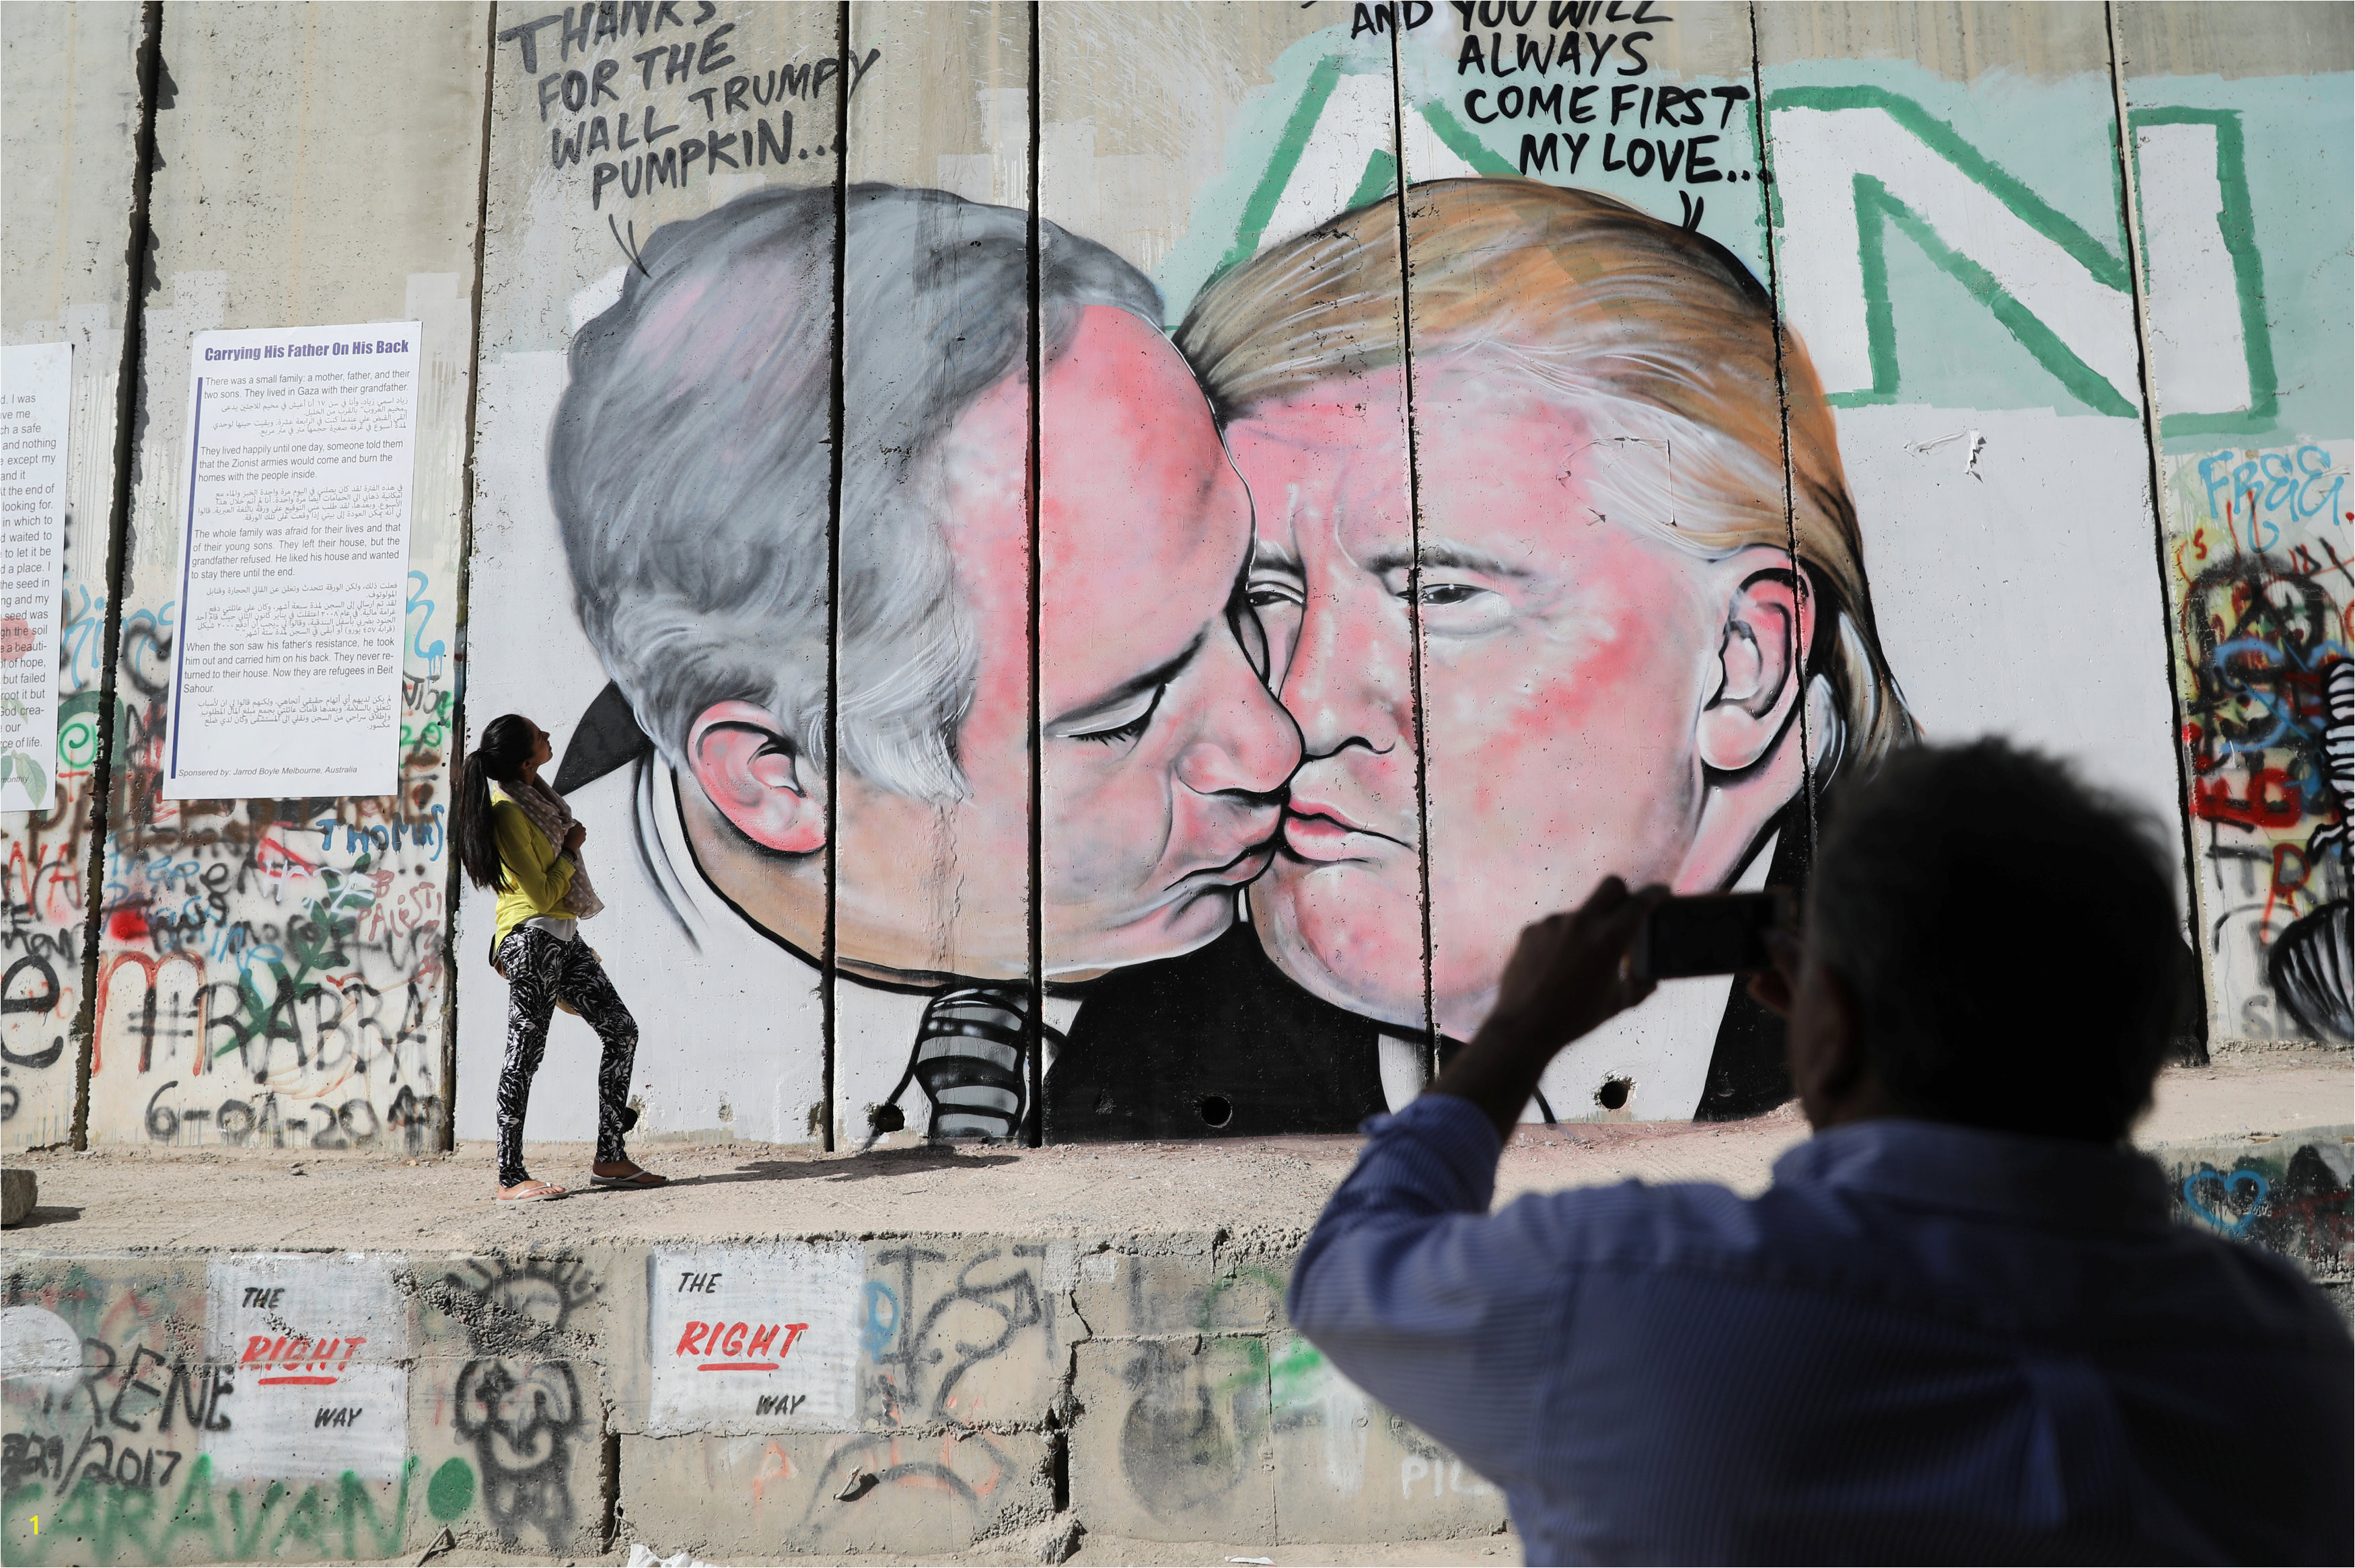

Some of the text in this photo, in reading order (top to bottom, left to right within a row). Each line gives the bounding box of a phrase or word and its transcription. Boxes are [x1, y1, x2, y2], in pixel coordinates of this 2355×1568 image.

[1350, 0, 1674, 39] AND YOU WILL
[1457, 31, 1654, 78] ALWAYS
[538, 23, 735, 122] FOR THE
[552, 48, 880, 170] WALL TRUMPY
[1463, 84, 1751, 129] COME FIRST
[592, 110, 838, 211] PUMPKIN...
[1519, 133, 1775, 185] MY LOVE...
[205, 339, 409, 361] Carrying His Father On His Back
[205, 377, 229, 385] There
[256, 375, 277, 384] small
[279, 373, 305, 384] family:
[315, 372, 345, 381] mother,
[347, 371, 372, 380] father,
[374, 369, 390, 379] and
[392, 369, 410, 378] their
[204, 391, 218, 399] two
[244, 388, 265, 400] They
[266, 387, 286, 397] lived
[288, 387, 295, 396] in
[297, 386, 319, 396] Gaza
[322, 385, 338, 394] with
[340, 384, 359, 394] their
[360, 383, 408, 395] grandfather.
[2, 438, 57, 451] and nothing
[201, 446, 221, 457] They
[222, 445, 241, 455] lived
[242, 445, 272, 455] happily
[273, 443, 290, 453] until
[308, 442, 325, 453] day,
[326, 442, 365, 451] someone
[366, 439, 381, 449] told
[383, 439, 403, 449] them
[7, 454, 56, 466] except my
[199, 453, 393, 469] that the Zionist armies would come and burn the
[198, 470, 317, 482] homes with the people inside.
[8, 483, 55, 496] the end of
[2, 499, 53, 513] looking for.
[3, 515, 53, 527] in which to
[9, 531, 52, 542] waited to
[5, 546, 51, 558] to let it be
[15, 577, 50, 589] seed in
[4, 609, 48, 621] seed was
[14, 624, 48, 636] the soil
[15, 640, 47, 652] beauti-
[186, 637, 394, 652] When the son saw his father's resistance, he took
[8, 657, 46, 670] of hope,
[3, 672, 46, 685] but failed
[22, 689, 28, 700] it
[30, 688, 45, 700] but
[20, 706, 44, 716] crea-
[15, 736, 42, 748] of life.
[178, 769, 219, 778] Sponsered
[219, 769, 231, 777] by:
[258, 768, 280, 776] Boyle
[324, 766, 357, 774] Australia
[316, 804, 445, 862] THOMAS
[678, 1271, 723, 1294] THE
[242, 1287, 285, 1309] THE
[676, 1320, 809, 1358] RIGHT
[239, 1335, 367, 1372] RIGHT
[756, 1394, 807, 1416] WAY
[314, 1407, 363, 1428] WAY
